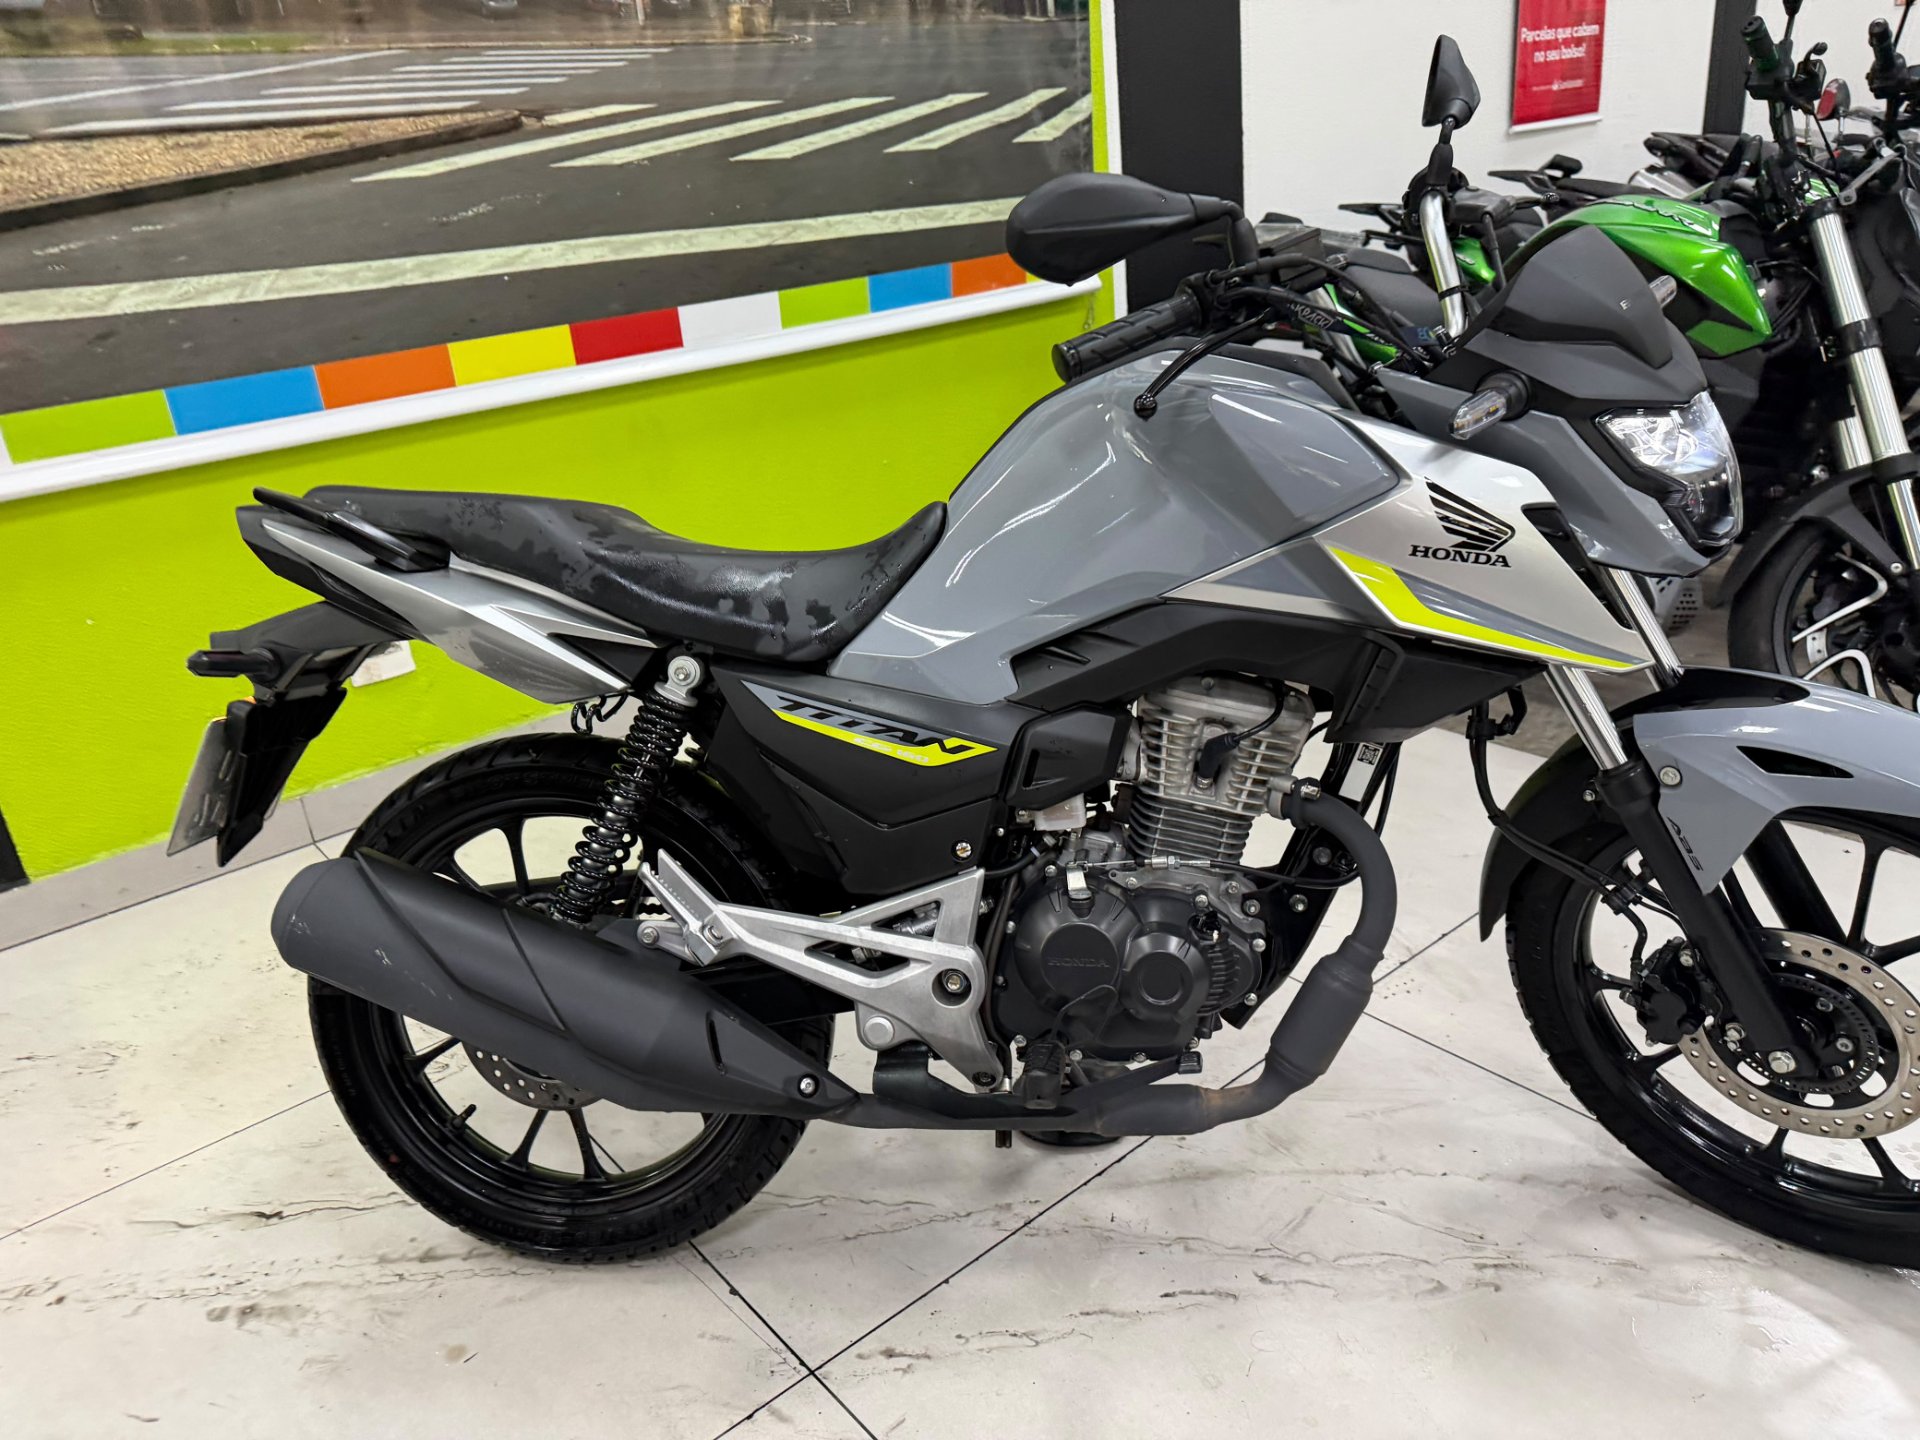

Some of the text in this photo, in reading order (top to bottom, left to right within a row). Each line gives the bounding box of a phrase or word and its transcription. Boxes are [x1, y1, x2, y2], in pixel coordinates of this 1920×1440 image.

[1521, 22, 1600, 43] Parcelas que cabem
[1533, 43, 1586, 63] no seu bolso!
[1408, 545, 1512, 569] HONDA
[776, 694, 977, 755] TITAN
[1666, 816, 1704, 871] ABS
[1047, 957, 1111, 968] HONDA
